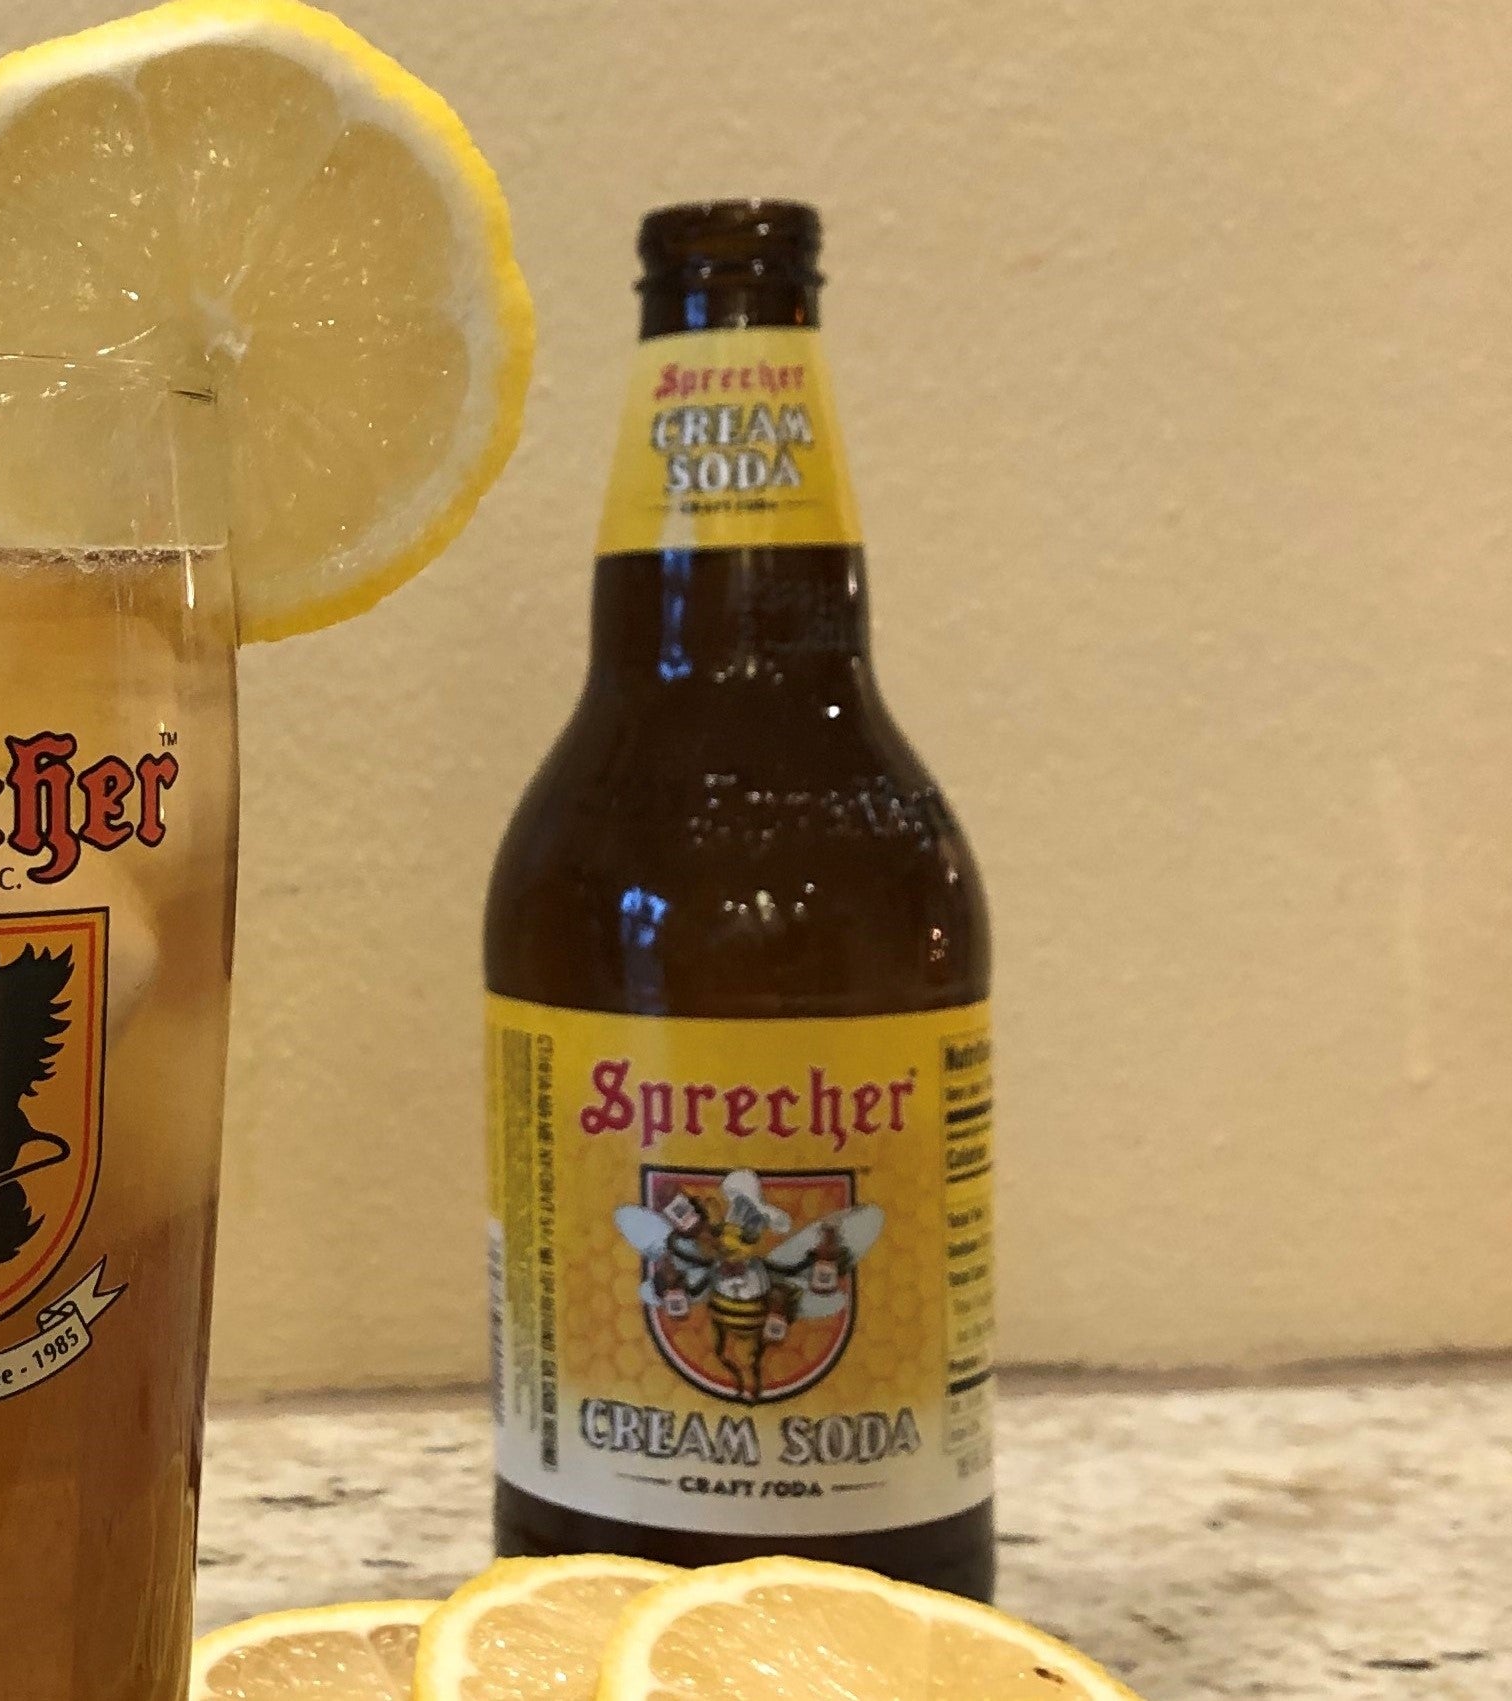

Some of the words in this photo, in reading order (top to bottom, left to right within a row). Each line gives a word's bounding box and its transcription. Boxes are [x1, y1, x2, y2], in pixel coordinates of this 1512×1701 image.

[654, 361, 805, 401] Sprecher
[651, 402, 816, 452] CREAM
[664, 448, 804, 495] SODA
[580, 1058, 916, 1154] Sprecher
[31, 1326, 80, 1370] 1985
[579, 1397, 761, 1468] CREAM
[778, 1405, 923, 1466] SODA
